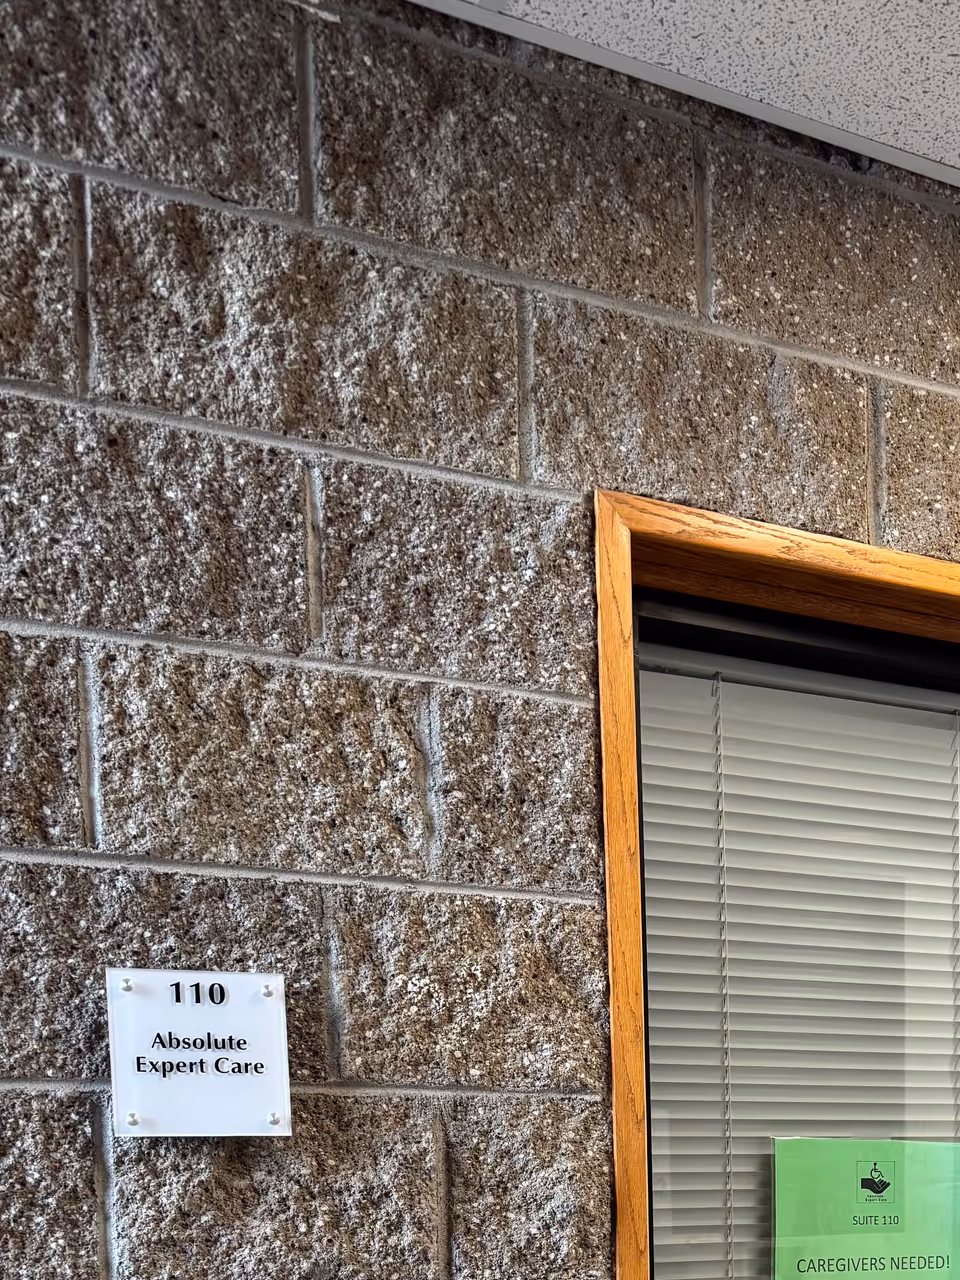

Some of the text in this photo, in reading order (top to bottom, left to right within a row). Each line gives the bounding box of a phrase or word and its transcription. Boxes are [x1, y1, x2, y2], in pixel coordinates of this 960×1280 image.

[170, 981, 226, 1005] 110
[151, 1031, 248, 1051] Absolute
[136, 1056, 265, 1079] Expert Care
[852, 1215, 899, 1225] SUITE 110
[796, 1255, 950, 1273] CAREGIVERS NEEDED!
